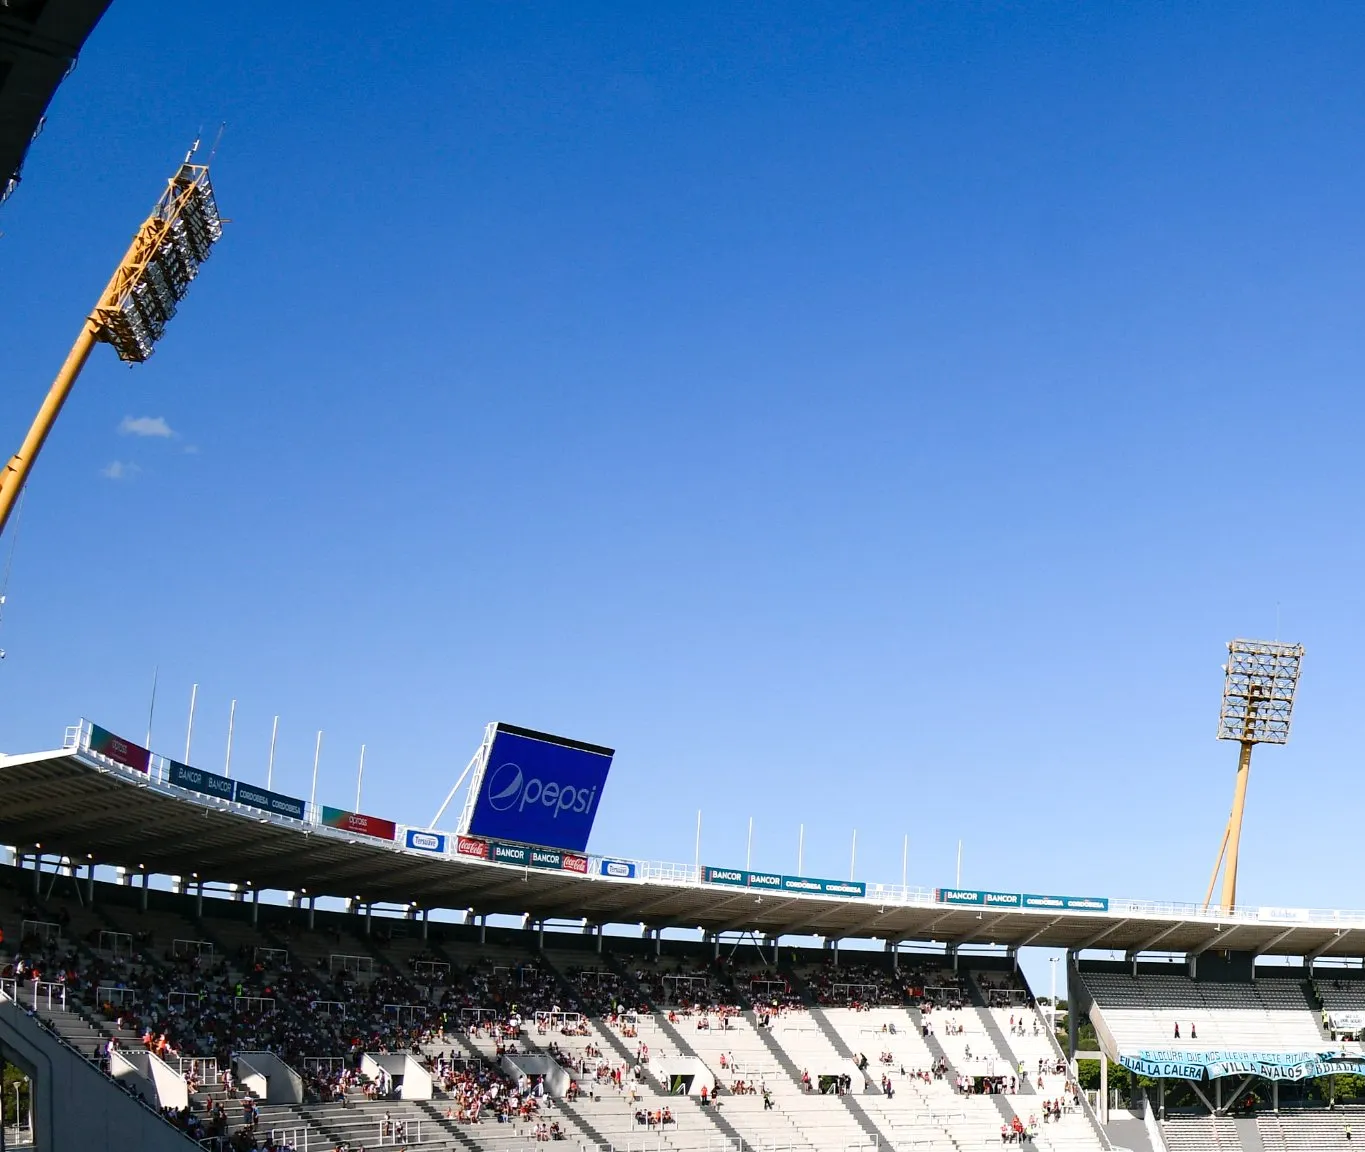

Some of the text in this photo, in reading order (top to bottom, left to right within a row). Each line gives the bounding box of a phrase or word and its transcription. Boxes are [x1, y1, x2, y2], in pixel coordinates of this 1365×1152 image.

[518, 777, 597, 818] pepsi
[496, 847, 560, 865] BANCOR BANCOR
[712, 870, 781, 886] BANCOR BANCOR
[947, 891, 1018, 904] BANCOR BANCOR
[1155, 1051, 1183, 1061] LOCURA
[1205, 1052, 1221, 1062] NOS
[1262, 1053, 1281, 1062] ESTE
[1121, 1055, 1202, 1079] FILIAL LA CALERA
[1221, 1062, 1303, 1078] VILLA AVALOS
